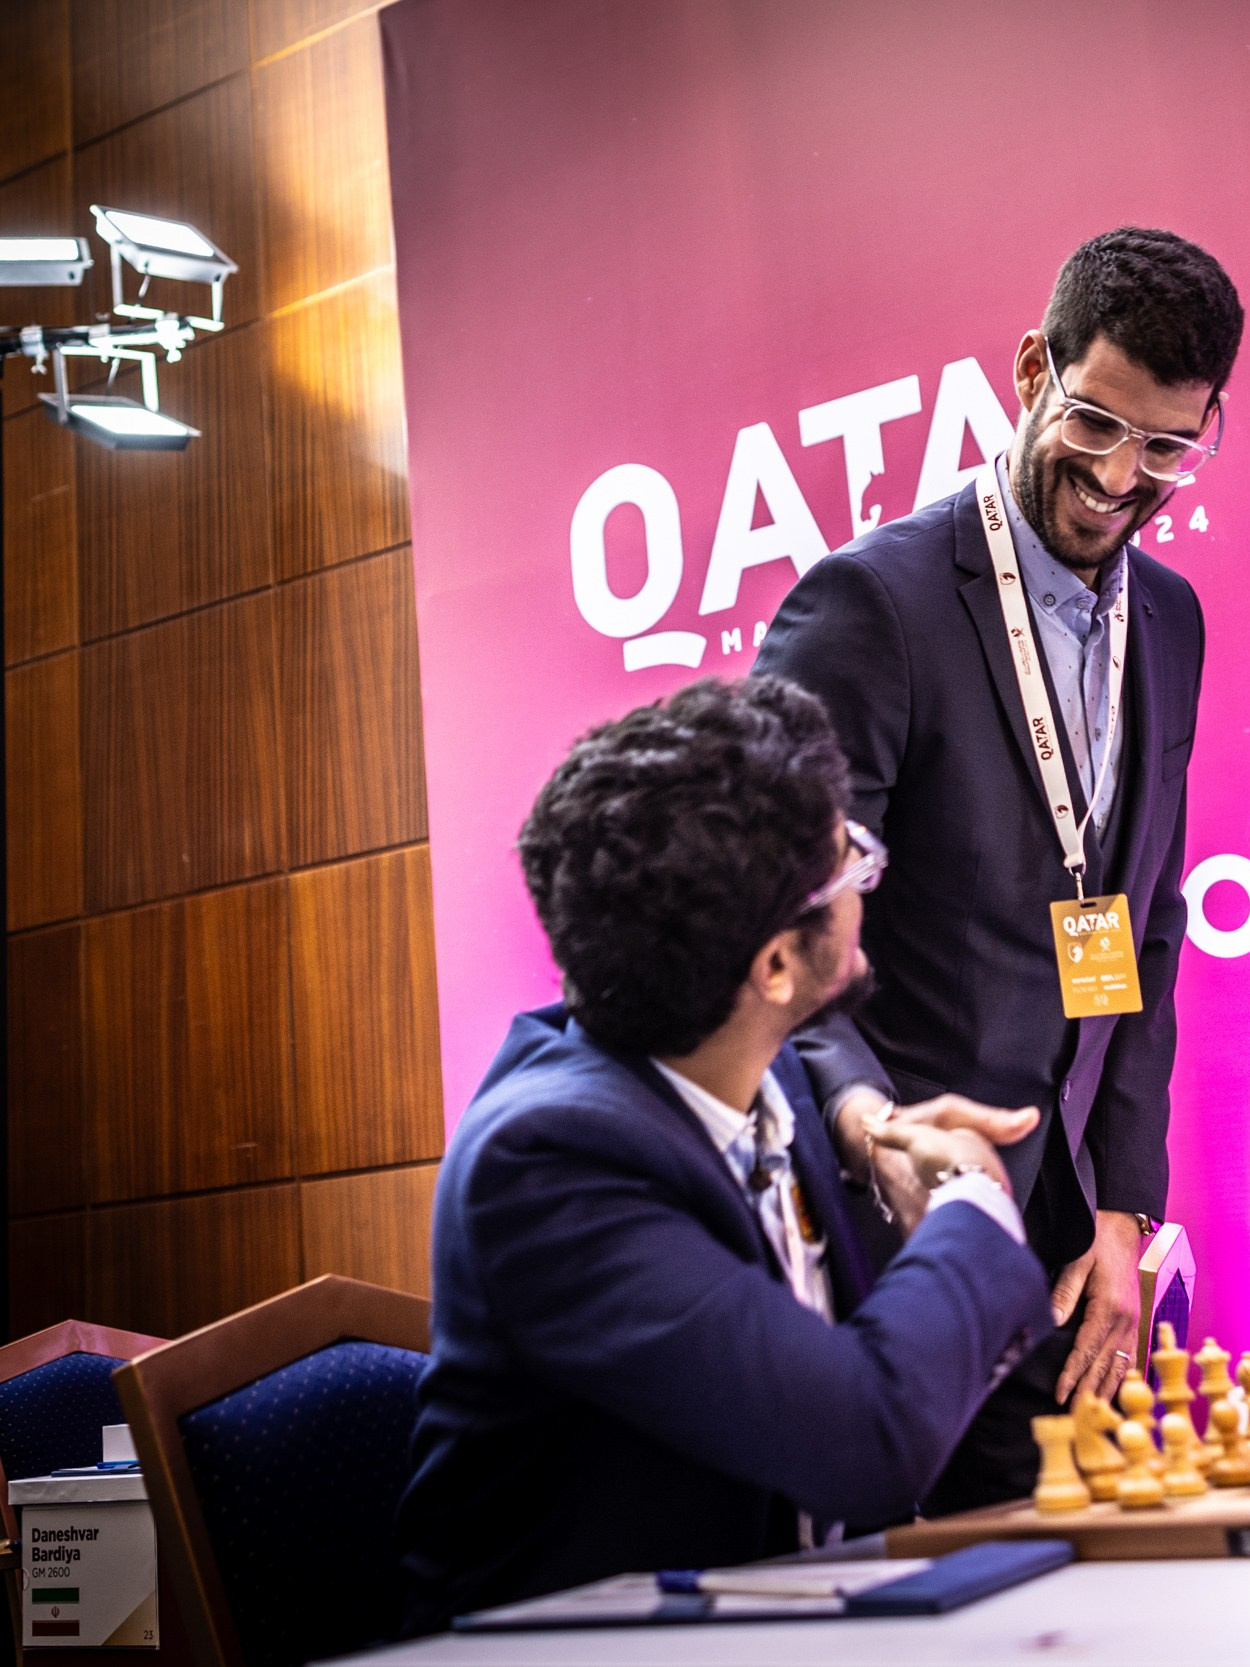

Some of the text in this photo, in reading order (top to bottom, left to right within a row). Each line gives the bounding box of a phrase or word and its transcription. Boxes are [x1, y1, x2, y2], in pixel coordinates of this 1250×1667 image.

[570, 356, 1017, 672] QATA
[983, 494, 1003, 532] QATAR
[1032, 716, 1055, 761] QATAR
[1062, 911, 1120, 937] QATAR
[32, 1526, 99, 1543] Daneshvar
[32, 1546, 81, 1564] Bardiya
[32, 1567, 70, 1578] GM 2600
